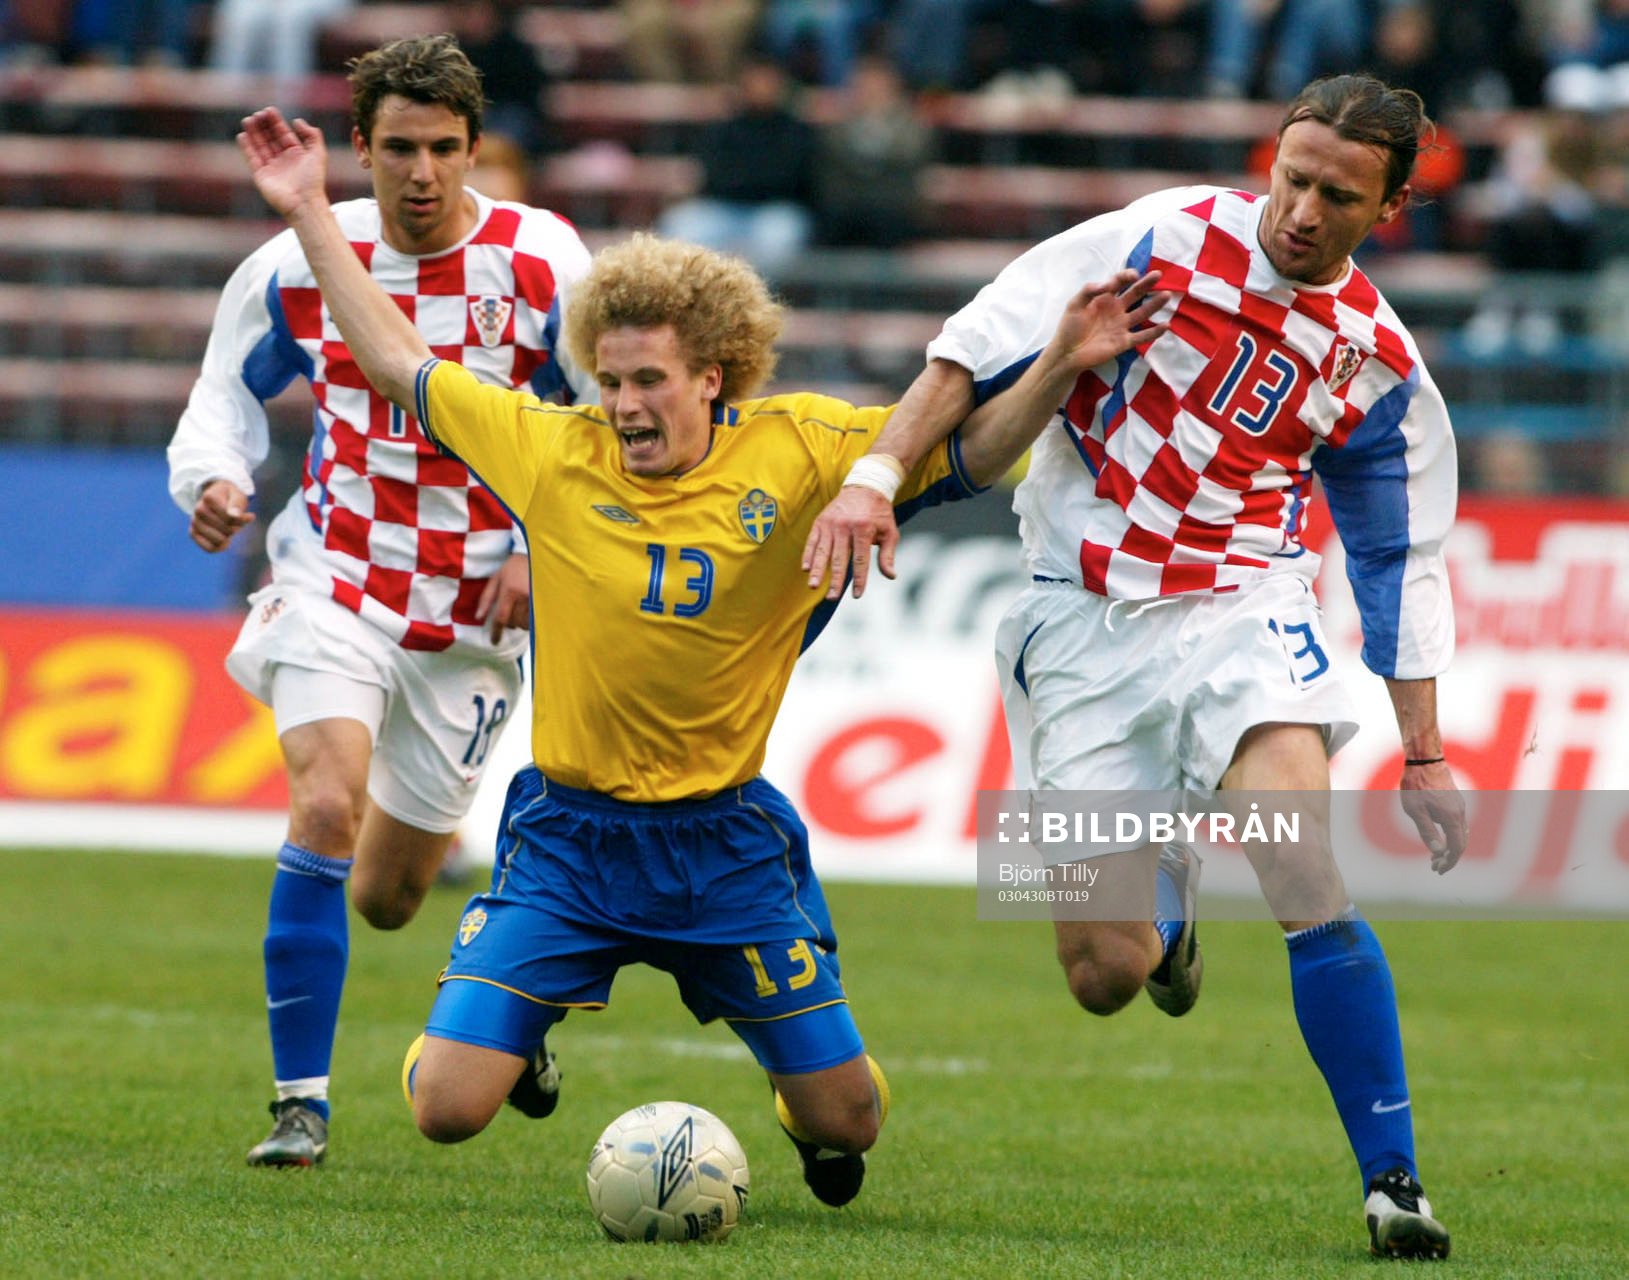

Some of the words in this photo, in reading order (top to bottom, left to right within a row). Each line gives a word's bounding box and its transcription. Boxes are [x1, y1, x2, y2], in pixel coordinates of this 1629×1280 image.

[1207, 330, 1299, 437] 13
[639, 542, 715, 619] 13
[743, 939, 817, 998] 13
